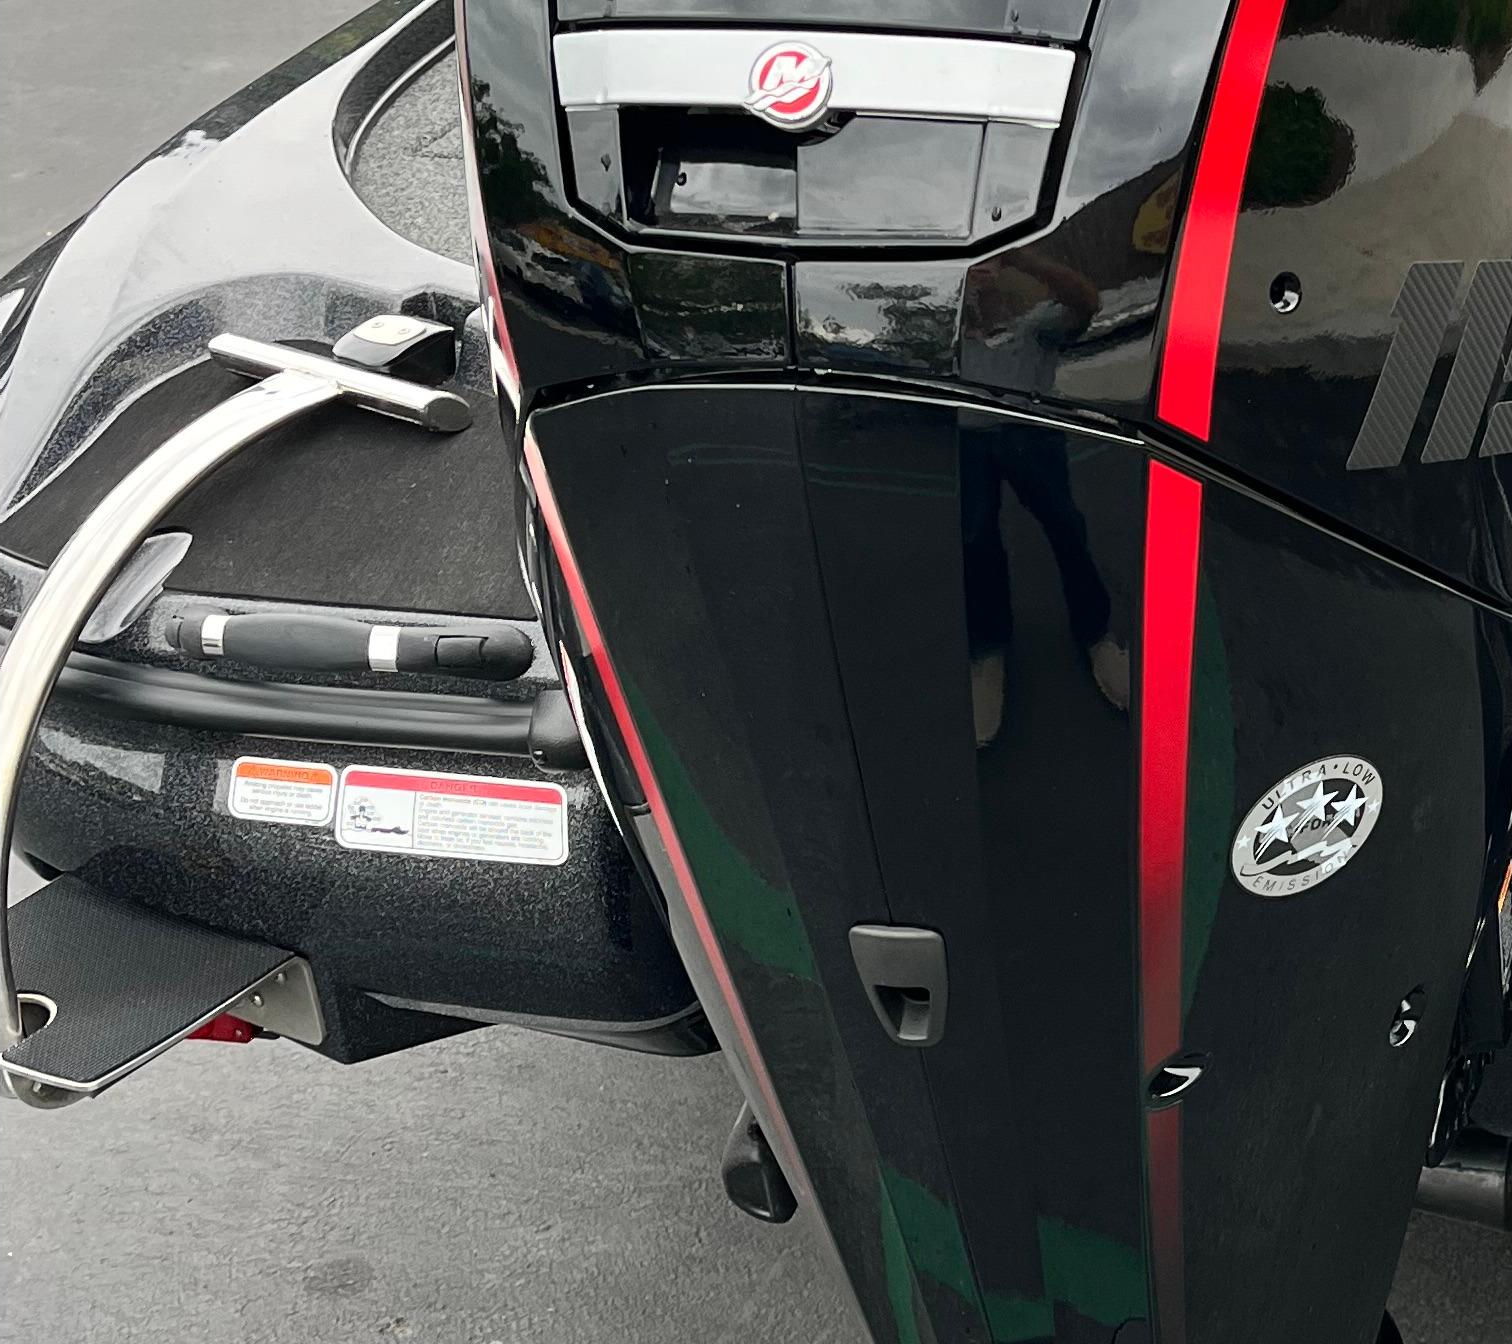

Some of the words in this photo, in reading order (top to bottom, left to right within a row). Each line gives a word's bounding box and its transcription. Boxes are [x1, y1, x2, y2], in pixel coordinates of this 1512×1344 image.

[1261, 764, 1326, 810] ULTRA
[1342, 762, 1375, 786] LOW
[1252, 848, 1349, 892] EMISSION
